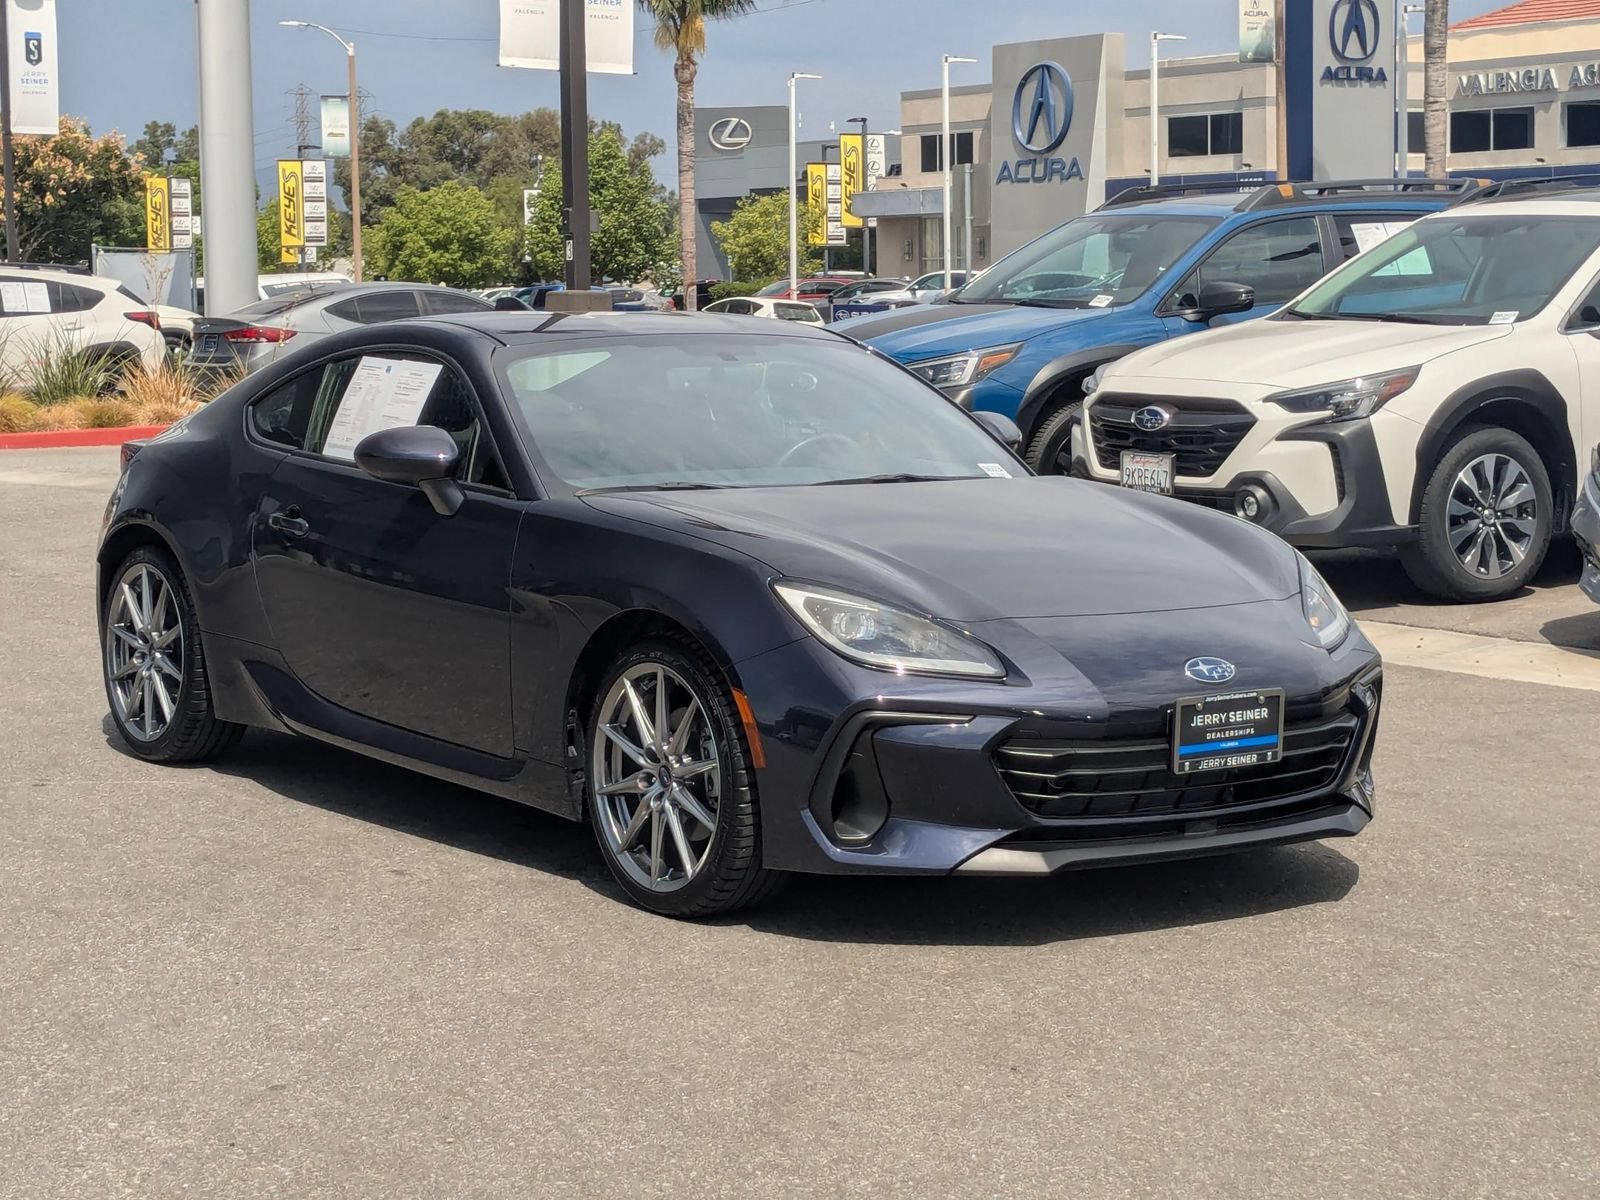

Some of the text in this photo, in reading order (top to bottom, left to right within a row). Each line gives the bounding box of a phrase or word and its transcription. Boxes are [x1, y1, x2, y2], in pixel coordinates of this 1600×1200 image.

[1319, 65, 1389, 82] ACURA
[1456, 63, 1600, 97] VALENCIA AC
[995, 156, 1085, 185] ACURA
[283, 171, 299, 238] KEYES
[150, 186, 166, 249] KEYES
[1125, 467, 1169, 488] 9KRE647
[1190, 707, 1269, 727] JERRY SEINER
[1206, 728, 1255, 740] DEALERSHIPS
[1198, 754, 1258, 770] JERRY SEINER
